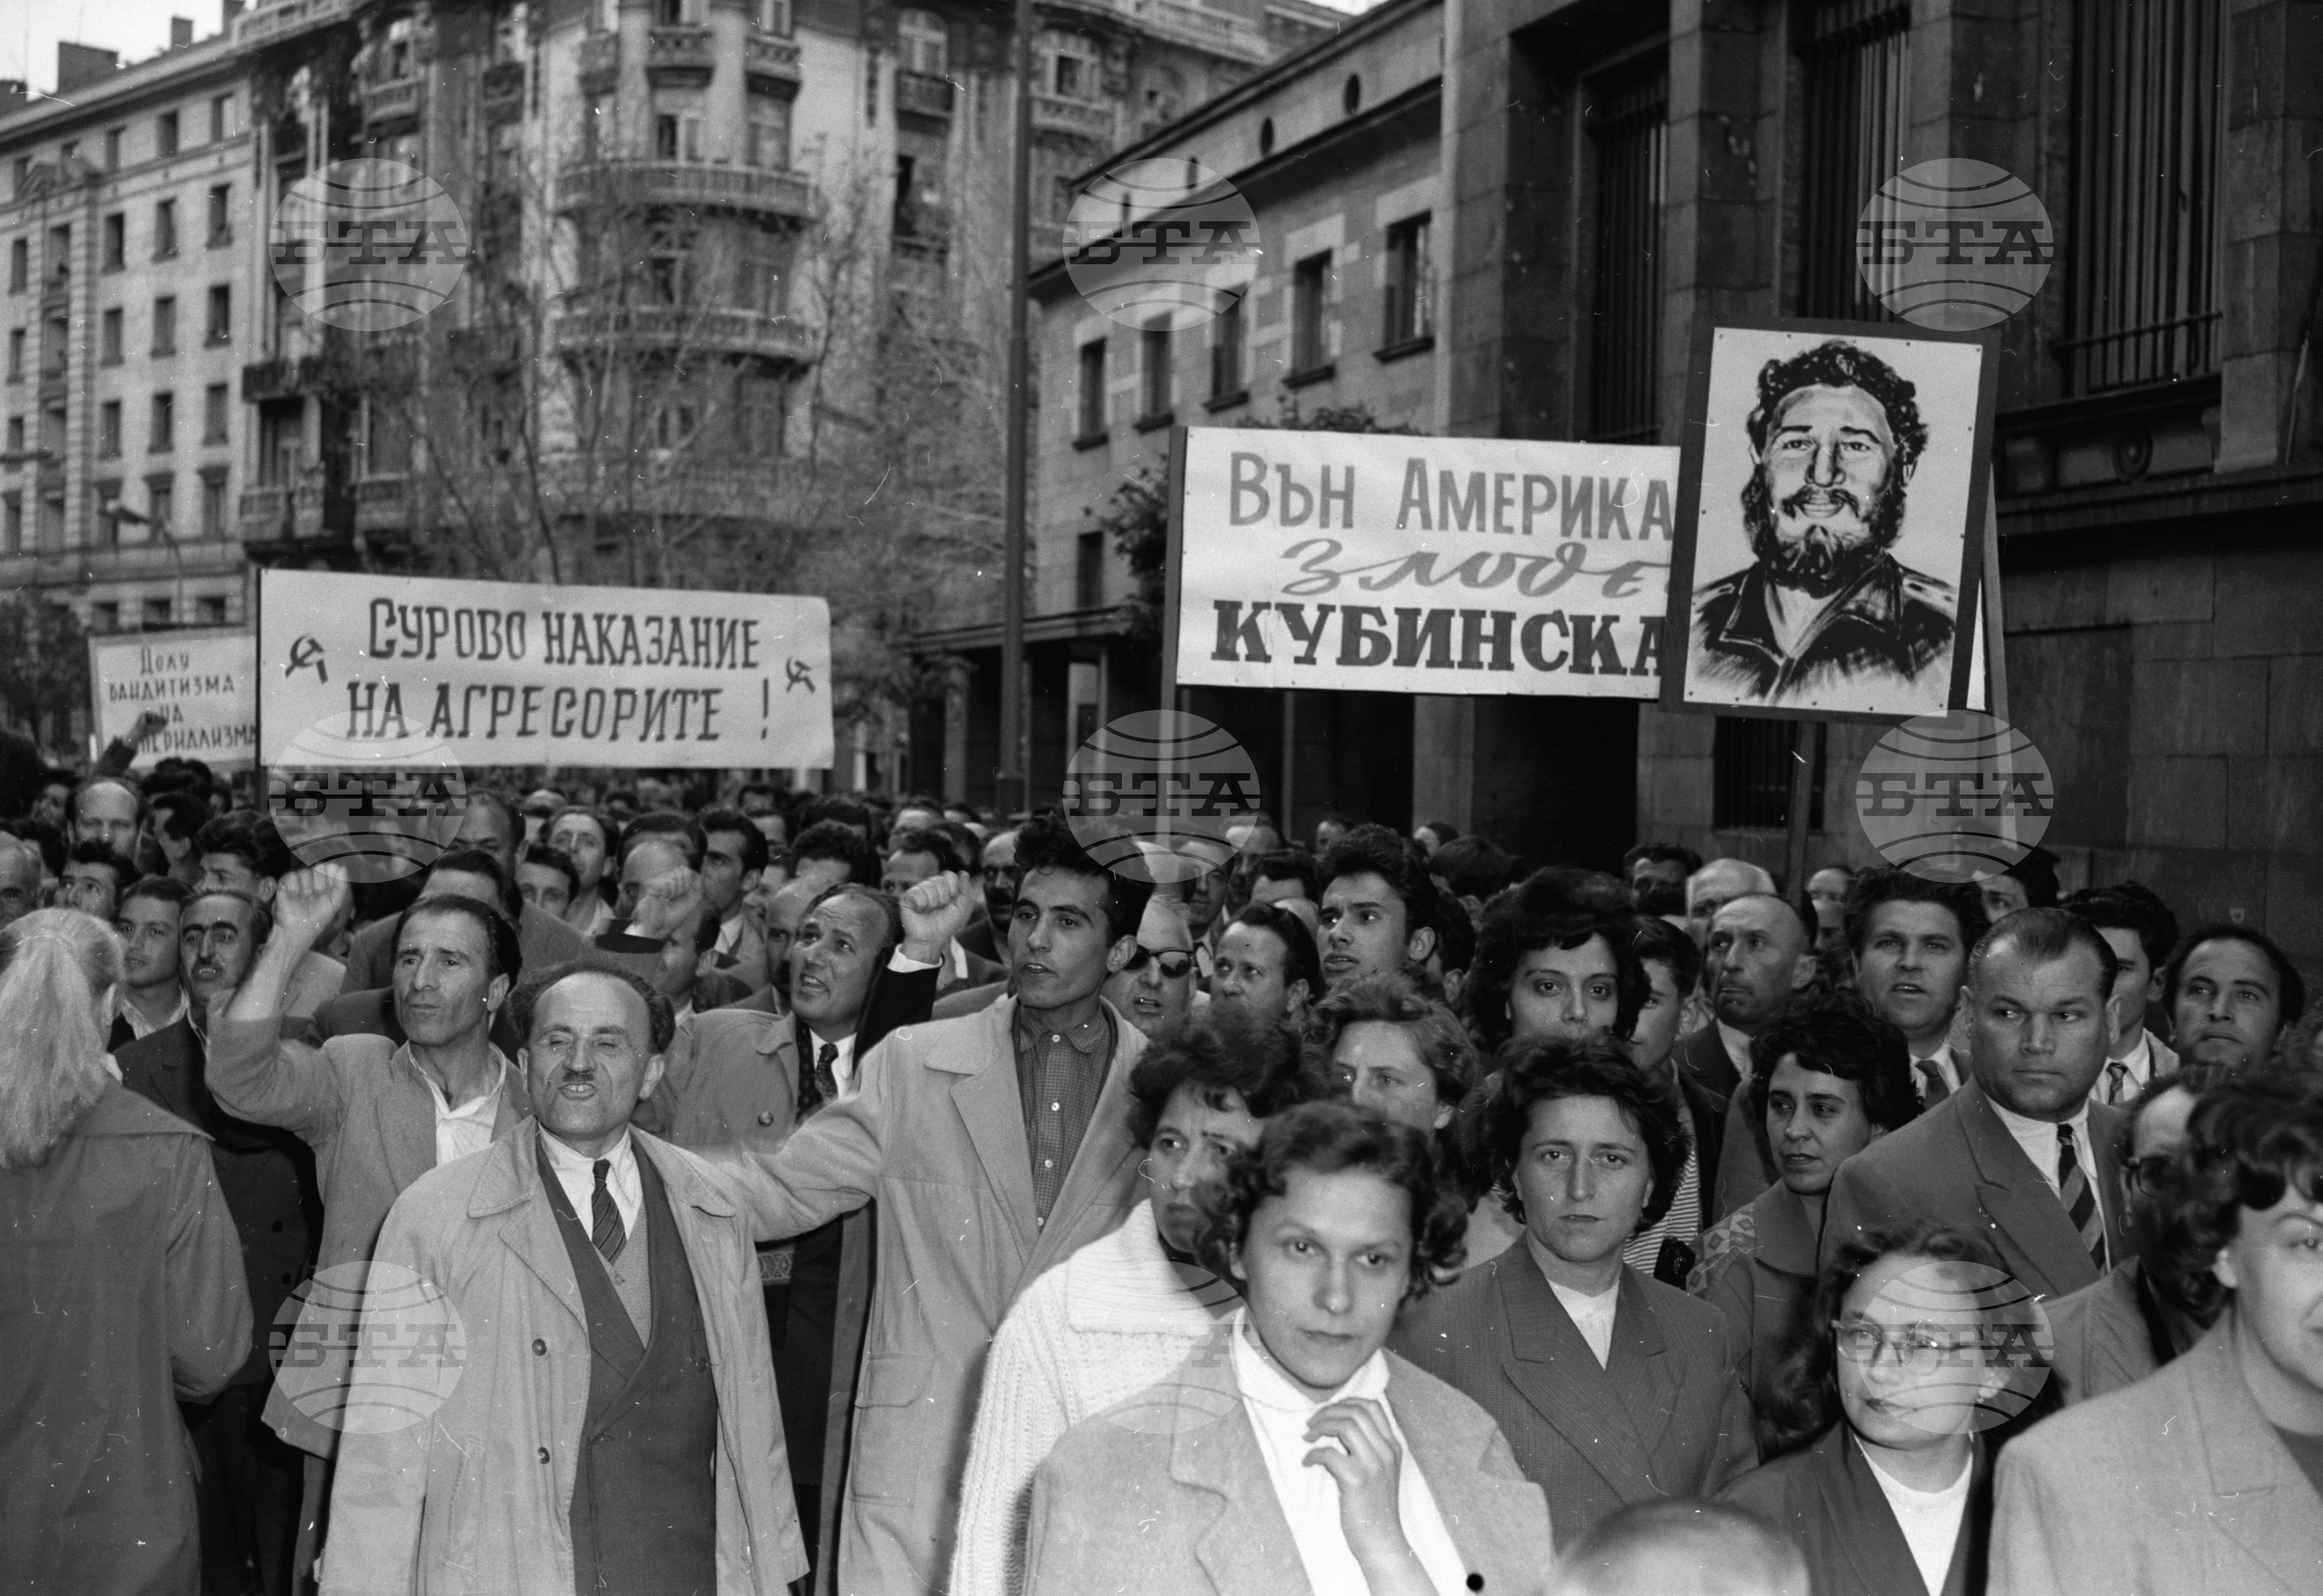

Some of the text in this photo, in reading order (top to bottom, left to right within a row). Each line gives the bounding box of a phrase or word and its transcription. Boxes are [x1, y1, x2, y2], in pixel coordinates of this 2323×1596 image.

[1229, 451, 1674, 541] ВЪН АМЕРИКА
[1280, 538, 1671, 598] Злоде
[369, 597, 760, 669] СУРОВО НАКАЗАНИЕ
[1211, 599, 1666, 677] КУБИНСКА
[346, 682, 408, 738] НА
[425, 684, 723, 742] АГРЕСОРИТЕ
